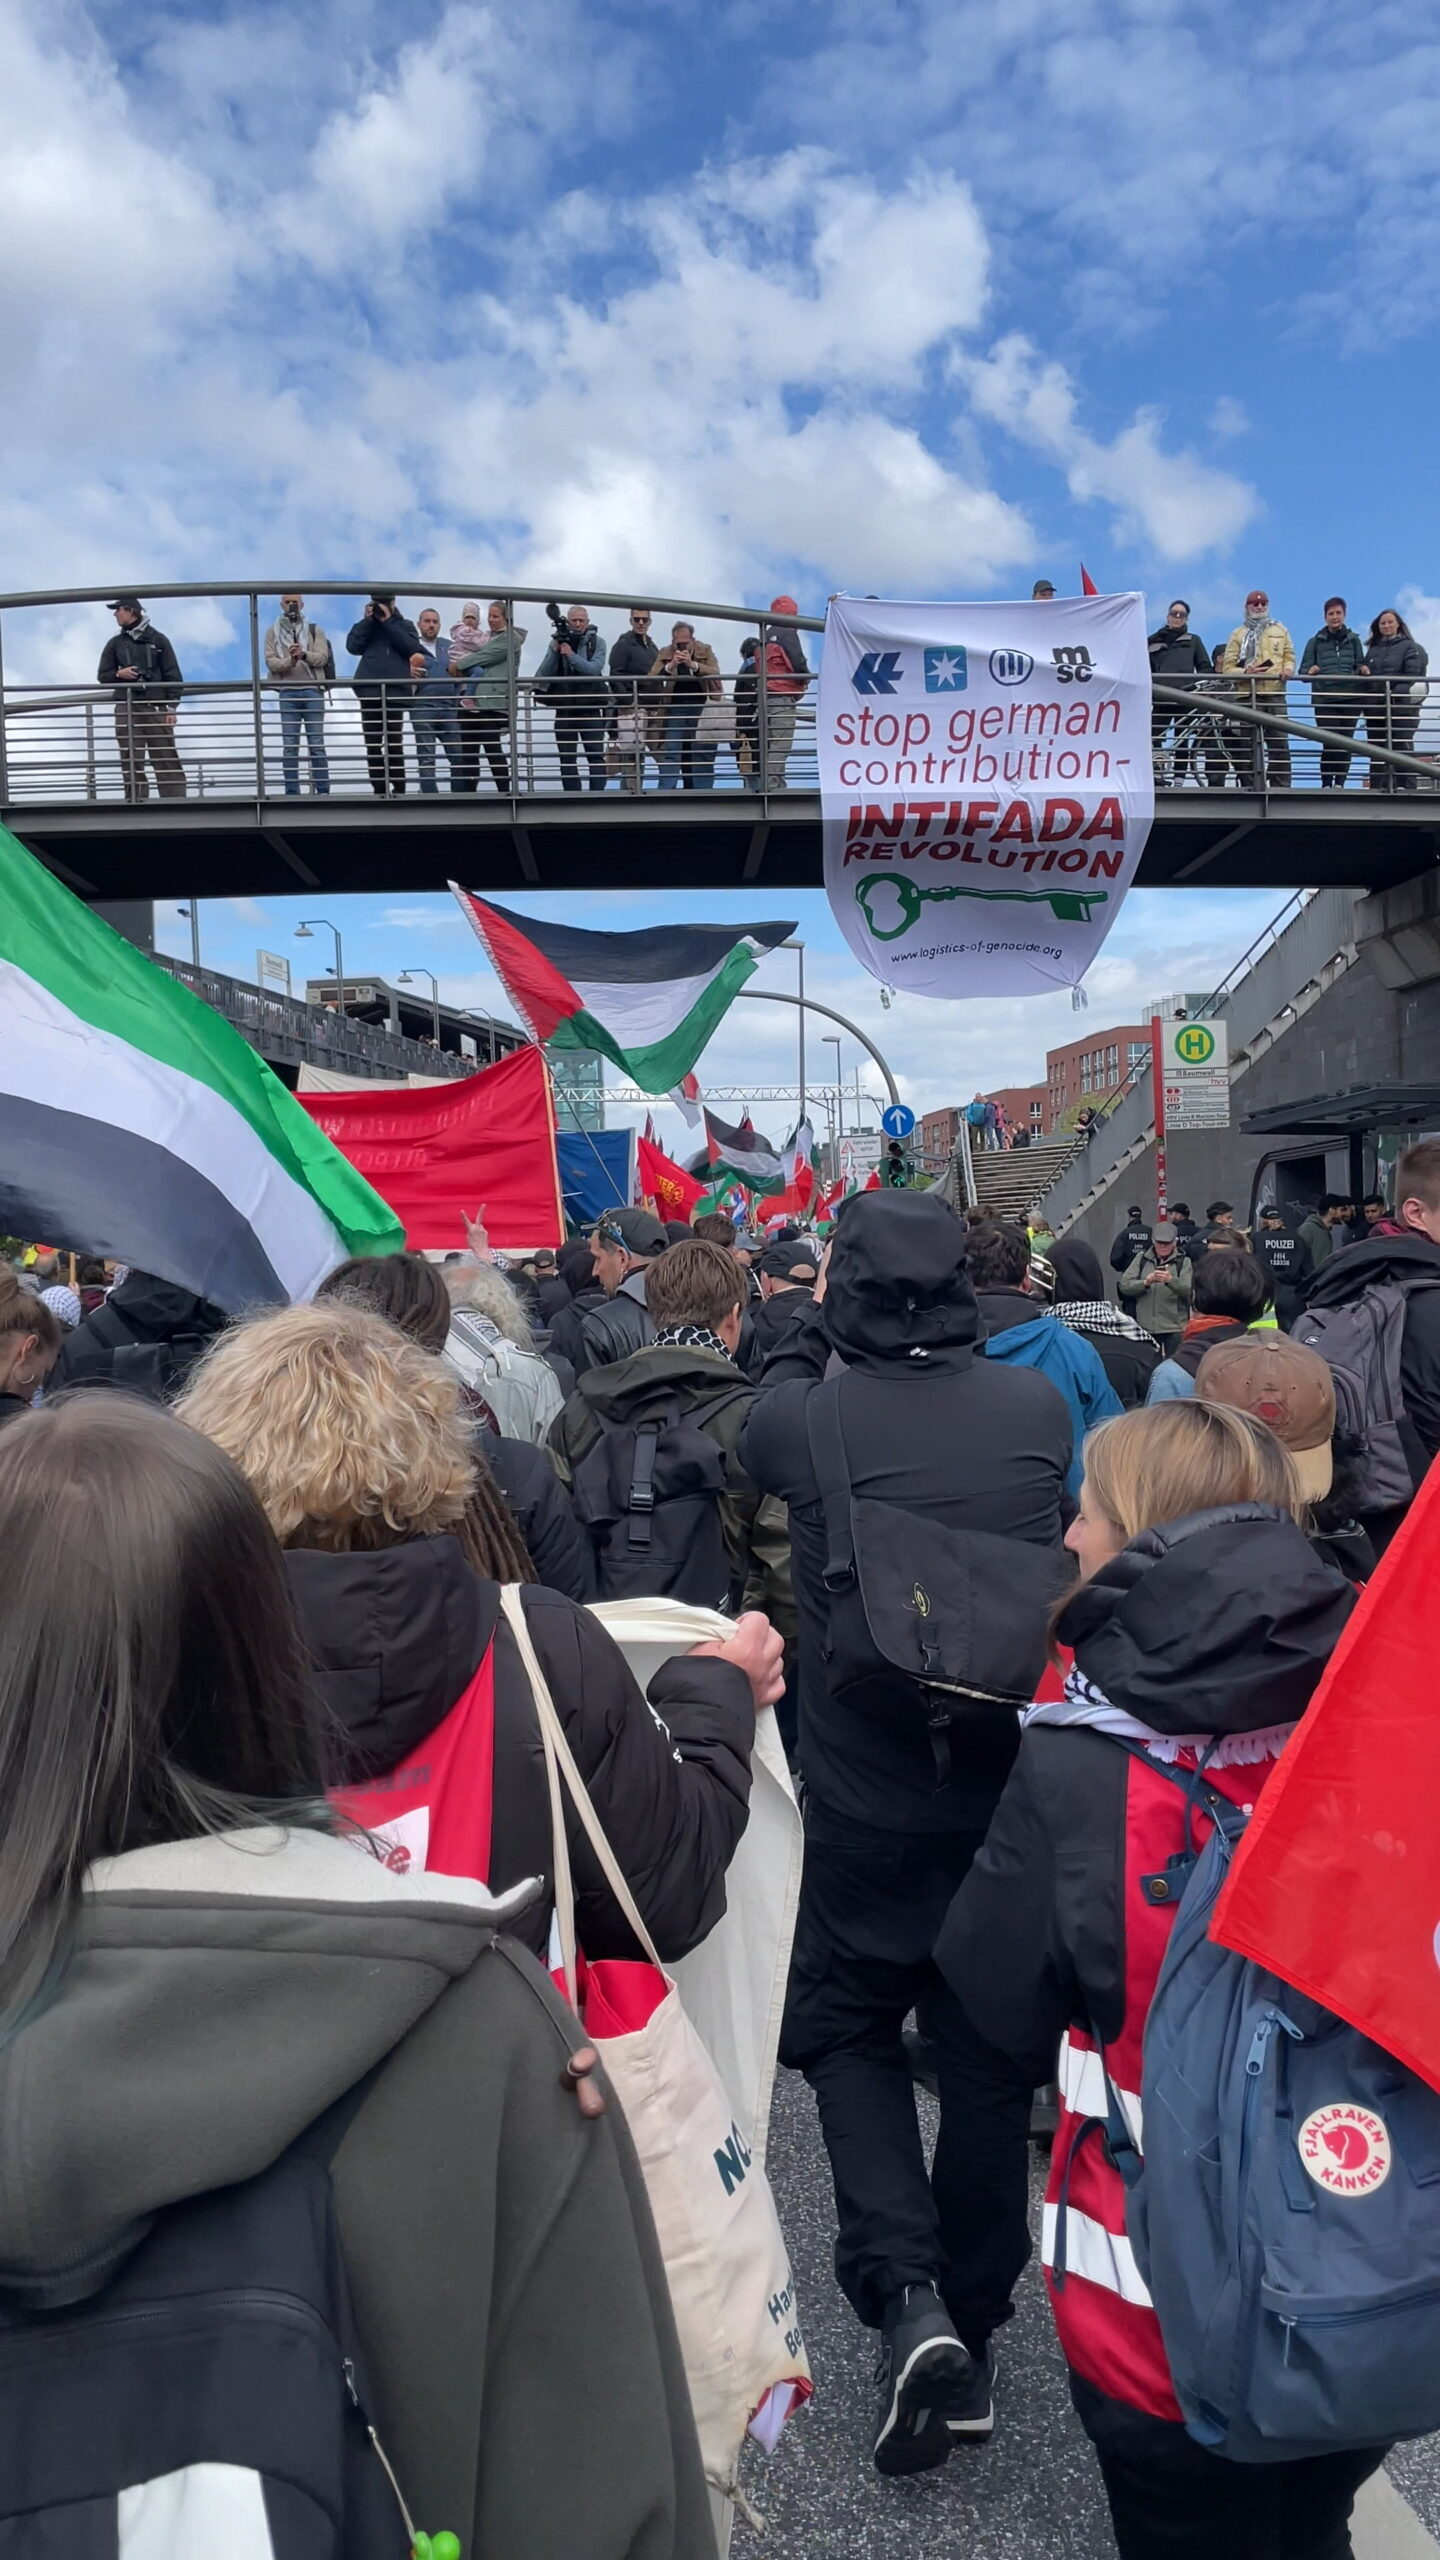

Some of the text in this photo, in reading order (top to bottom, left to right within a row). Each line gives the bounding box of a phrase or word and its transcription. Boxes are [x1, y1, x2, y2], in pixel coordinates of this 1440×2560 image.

[833, 699, 1121, 756] stop german
[839, 739, 1131, 786] contribution-
[846, 797, 1124, 843] INTIFADA
[843, 841, 1125, 878] REVOLUTION
[891, 940, 1063, 963] www.logistics-of-genocide.org
[1185, 1033, 1204, 1055] H
[1265, 1239, 1294, 1249] POLIZEI
